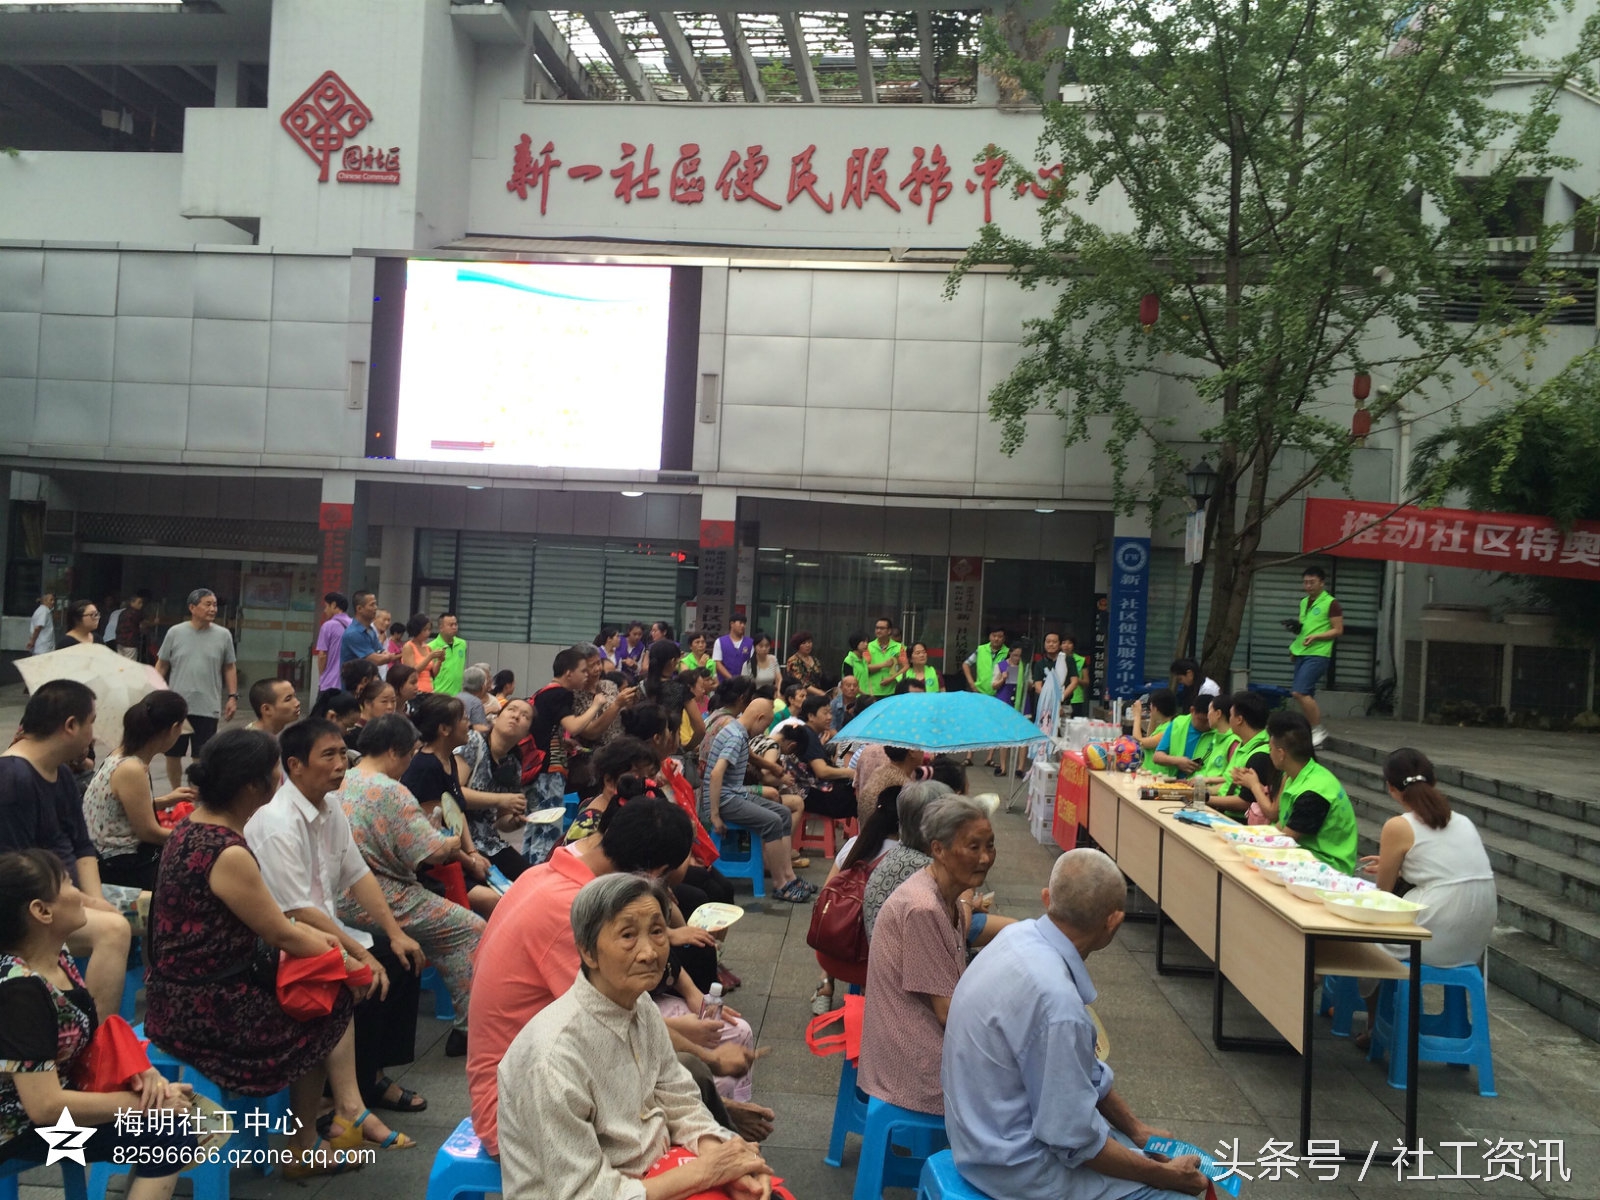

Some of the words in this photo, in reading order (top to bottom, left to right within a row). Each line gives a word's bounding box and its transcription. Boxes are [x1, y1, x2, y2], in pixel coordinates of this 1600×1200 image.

[338, 172, 361, 180] Chinese
[362, 173, 397, 182] Community
[1340, 511, 1600, 566] 推动社区特奥
[1115, 574, 1141, 695] 新一社区便民服务中心
